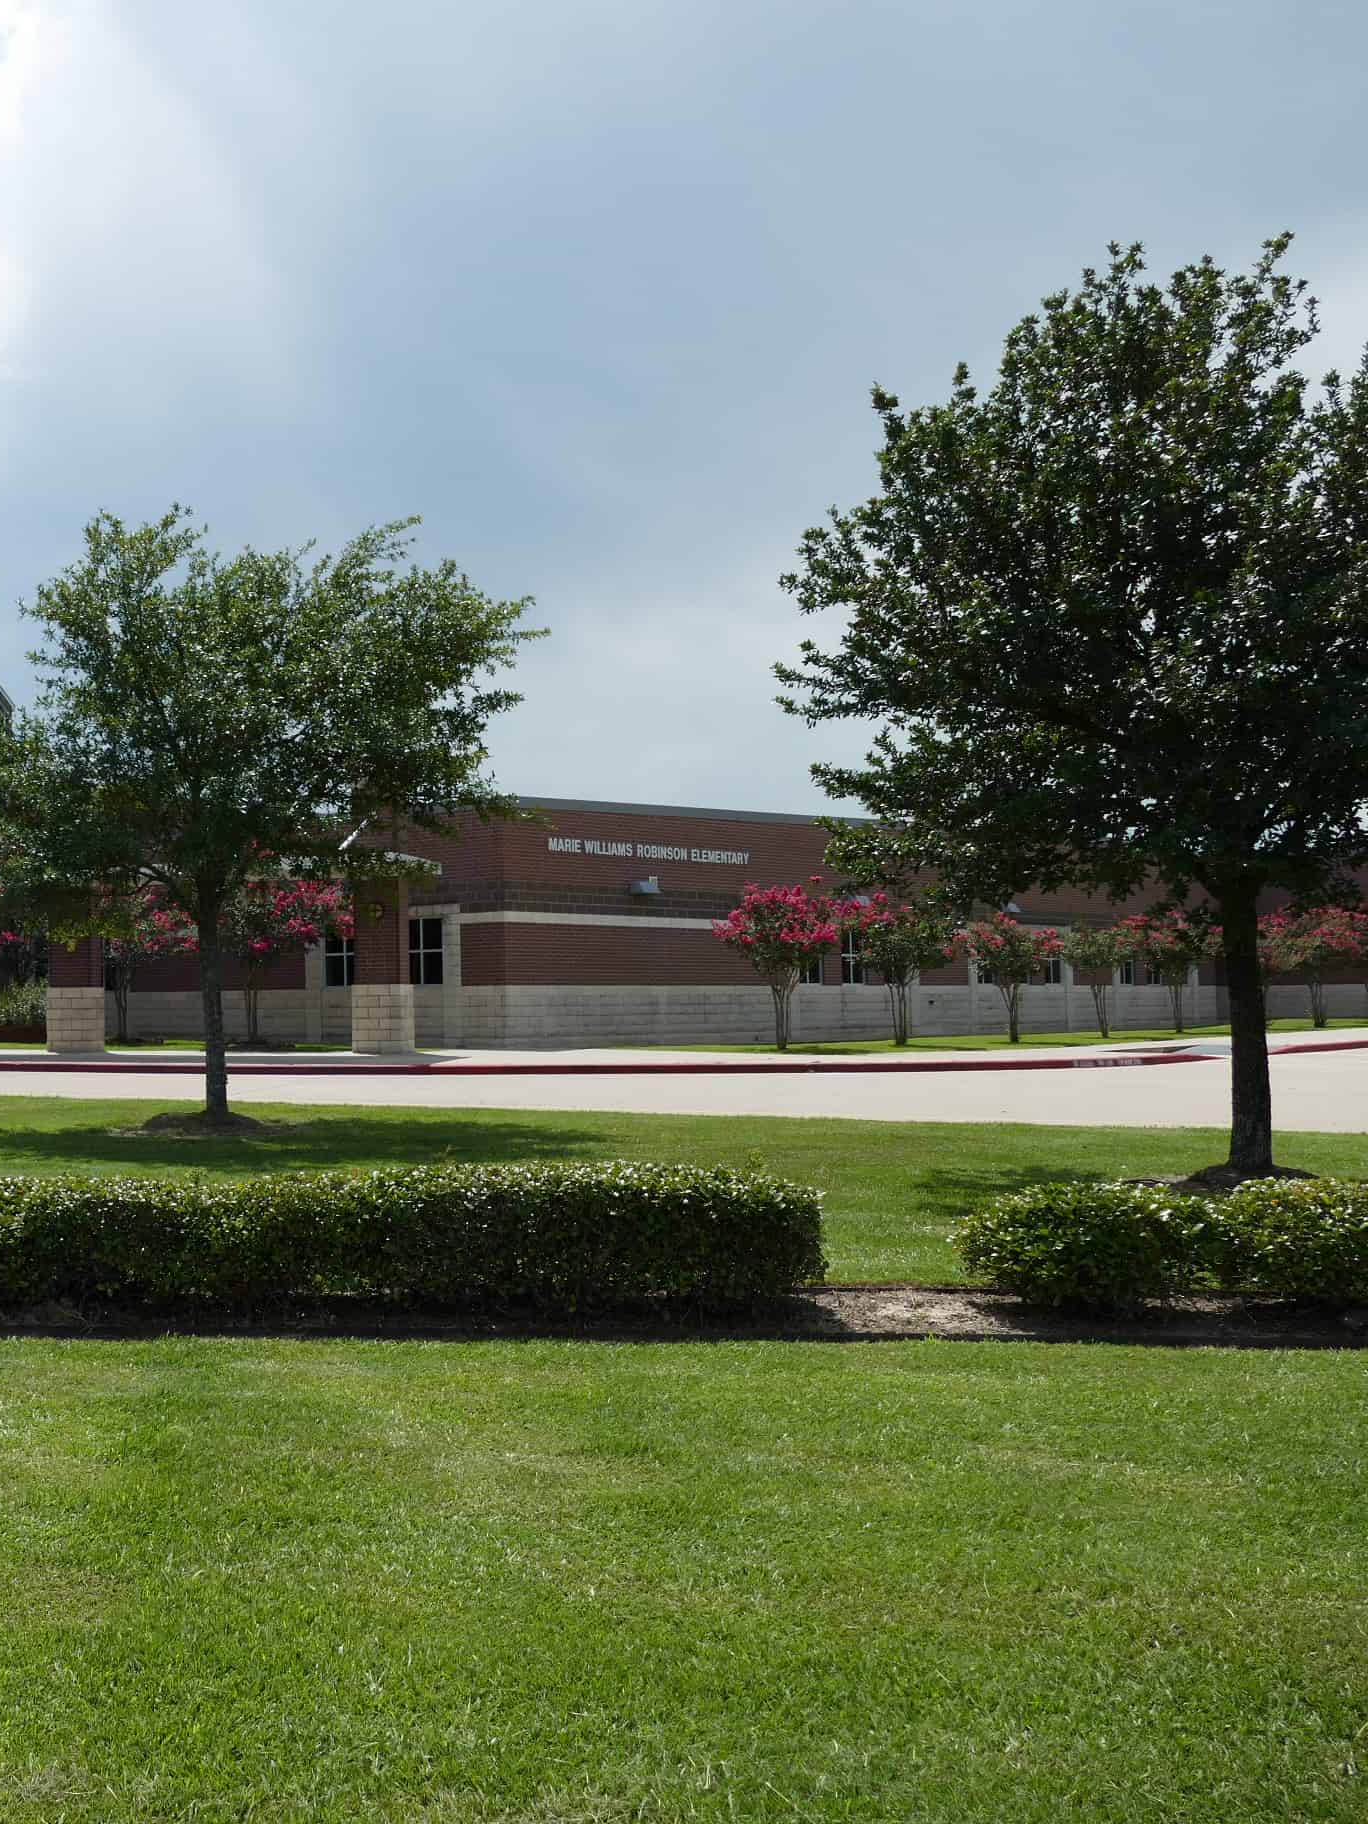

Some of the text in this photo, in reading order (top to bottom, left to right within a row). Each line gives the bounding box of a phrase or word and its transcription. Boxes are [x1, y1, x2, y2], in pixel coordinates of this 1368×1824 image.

[548, 838, 749, 864] MARIE WILLIAMS ROBINSON ELEMENTARY
